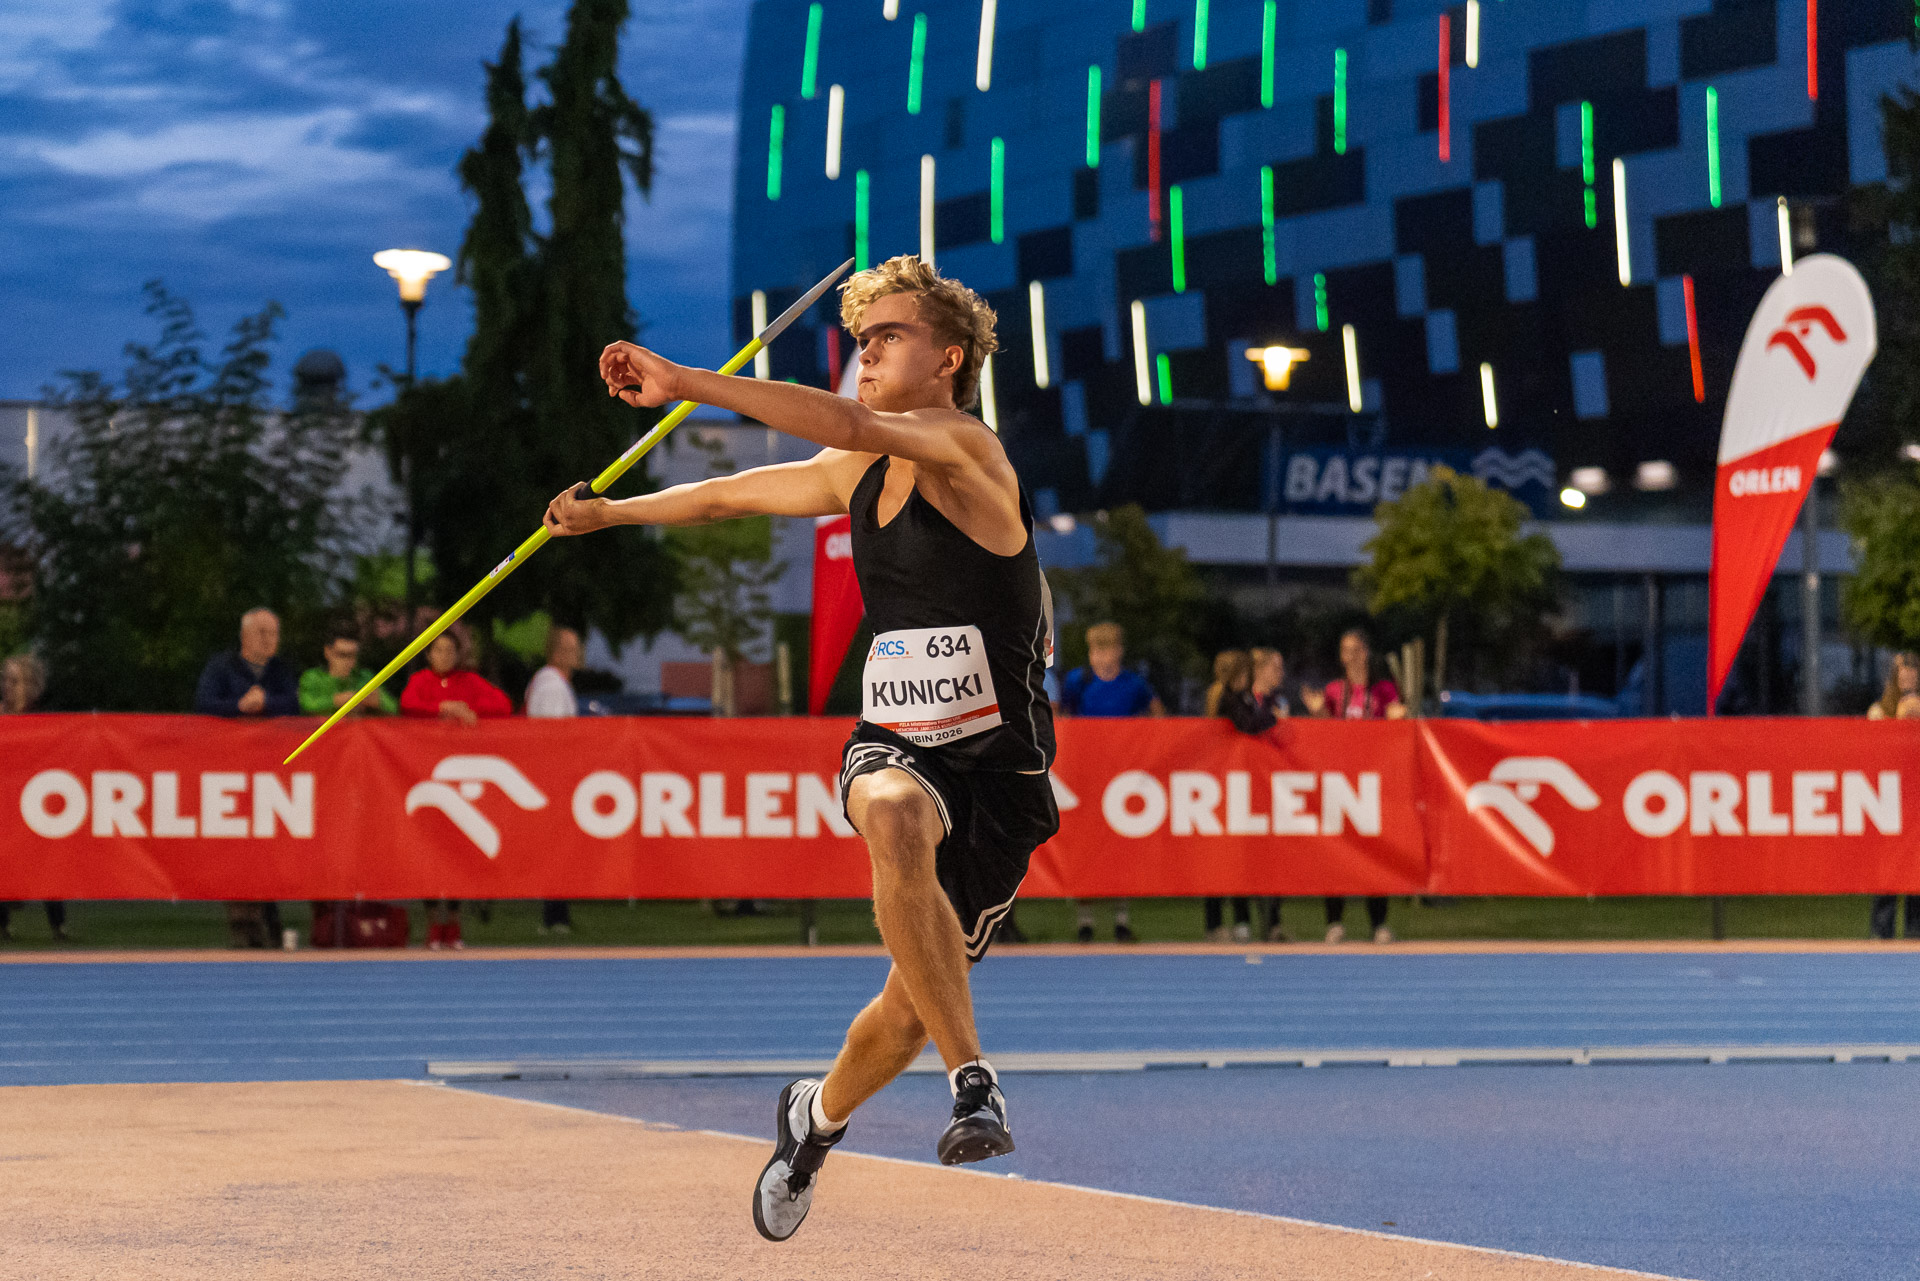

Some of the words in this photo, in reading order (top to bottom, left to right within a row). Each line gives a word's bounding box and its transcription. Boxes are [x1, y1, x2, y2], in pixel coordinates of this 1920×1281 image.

[1728, 466, 1801, 497] ORLEN
[926, 634, 971, 658] 634
[871, 673, 983, 707] KUNICKI
[908, 734, 933, 743] UBIN
[935, 727, 963, 740] 2026
[20, 769, 315, 839] ORLEN
[1101, 770, 1382, 838] ORLEN
[1622, 770, 1903, 838] ORLEN
